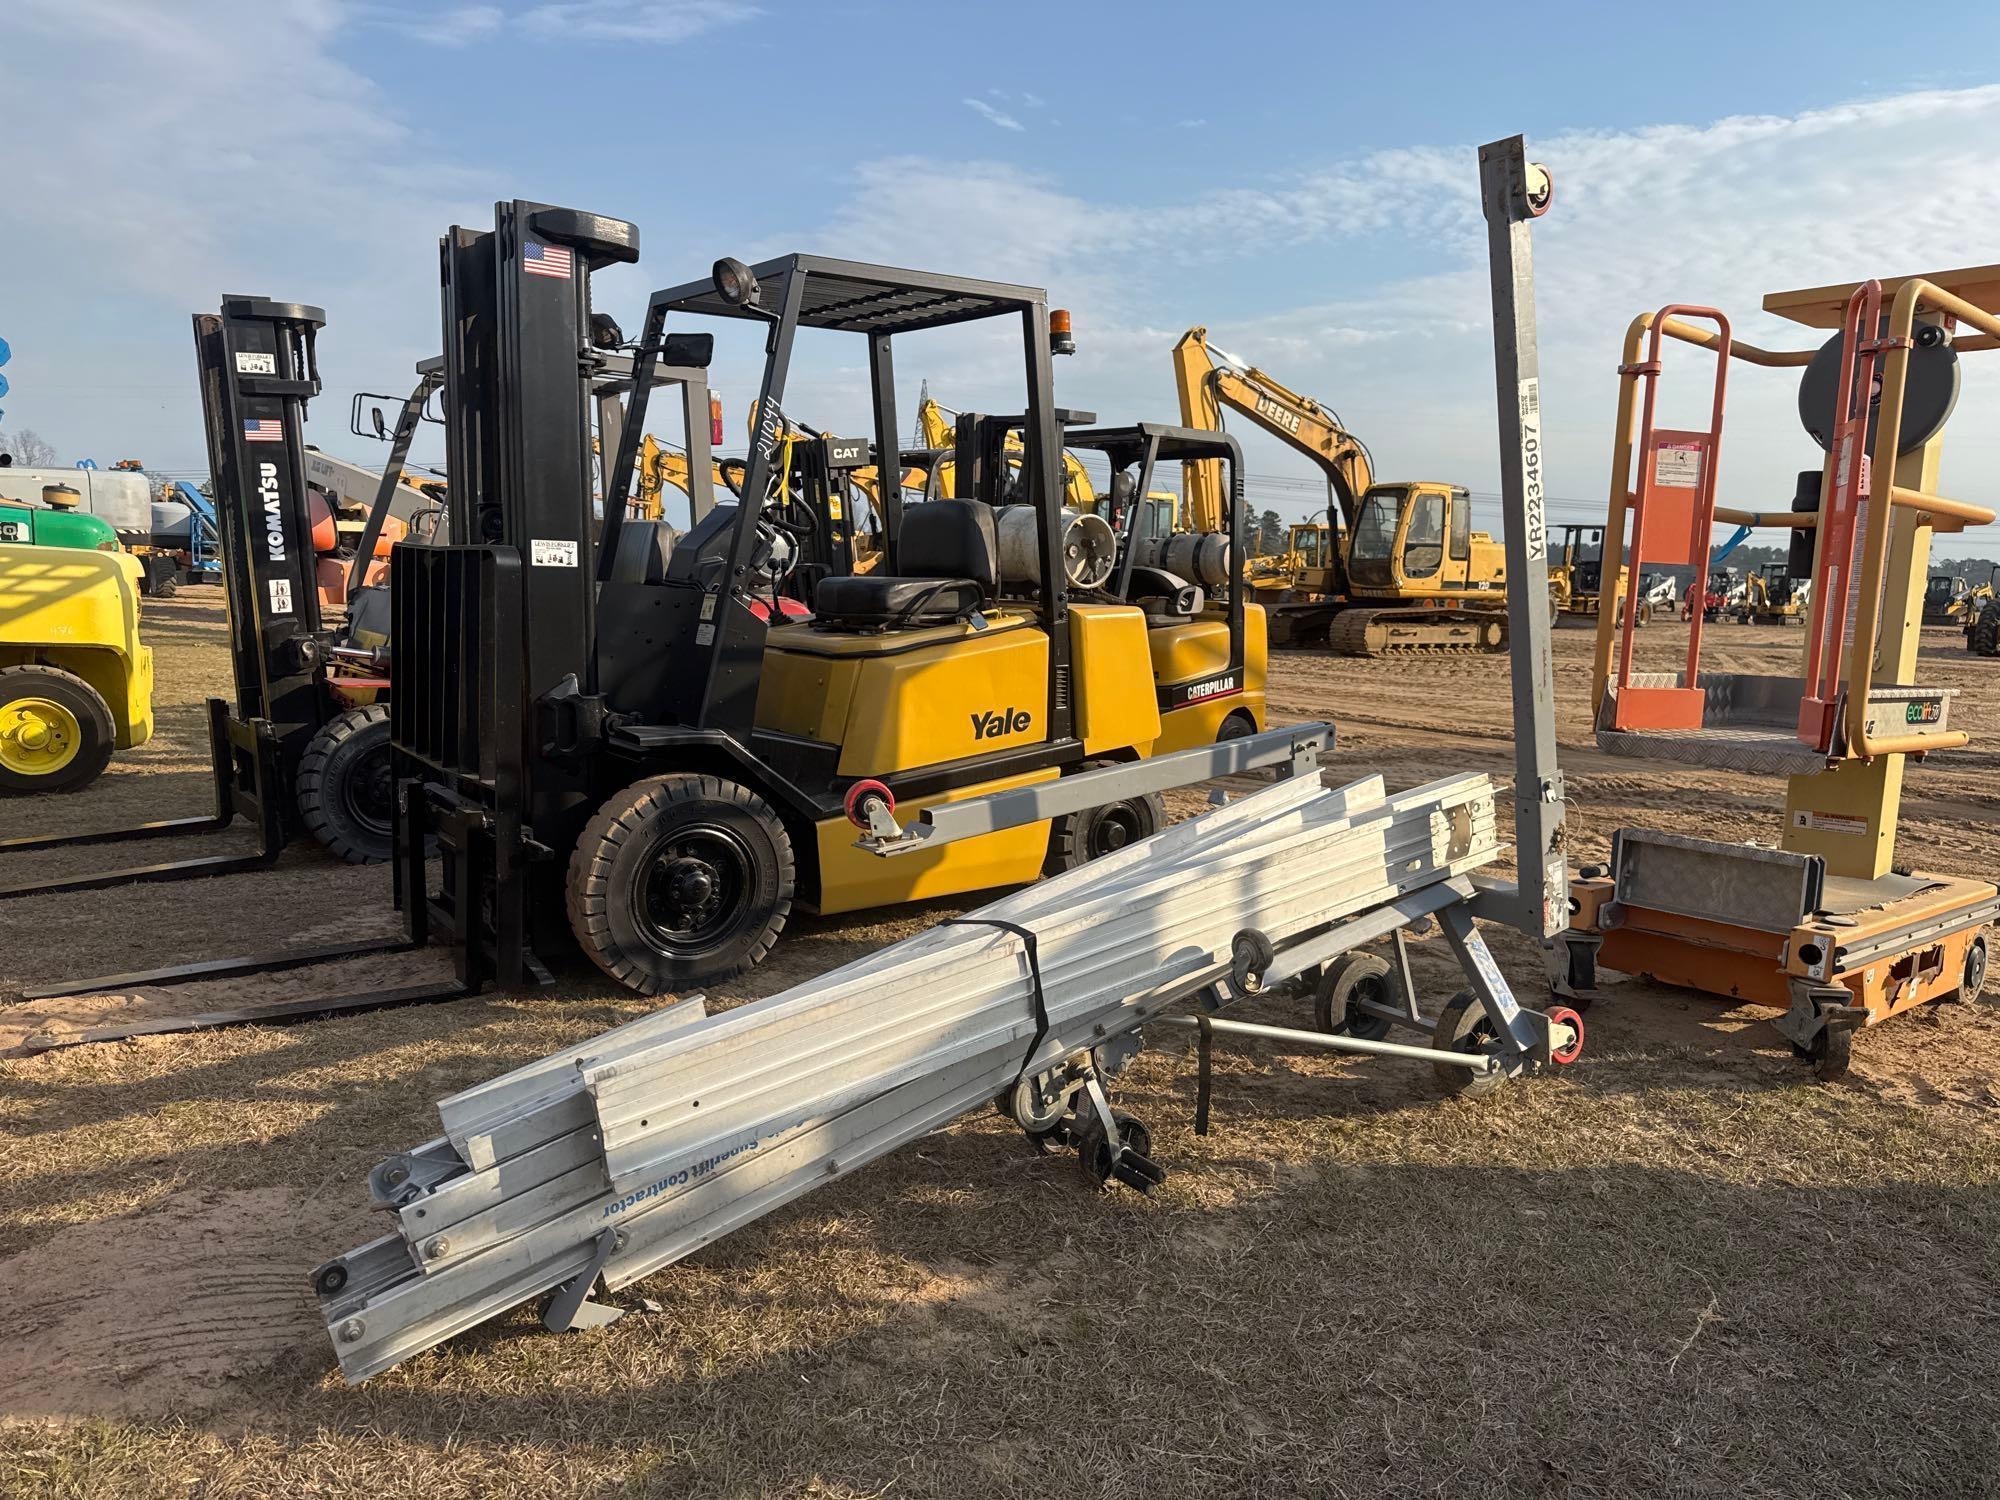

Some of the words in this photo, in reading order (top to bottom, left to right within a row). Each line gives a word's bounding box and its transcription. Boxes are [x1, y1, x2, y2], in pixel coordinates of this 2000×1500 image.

[757, 396, 781, 461] 211044
[1256, 395, 1300, 433] DEERE
[833, 447, 860, 459] CAT
[258, 462, 286, 561] KOMATSU
[1525, 425, 1542, 560] YR2234607
[1187, 676, 1234, 700] CATERPILLAR
[970, 707, 1032, 740] Yale
[602, 1170, 688, 1219] Contractor
